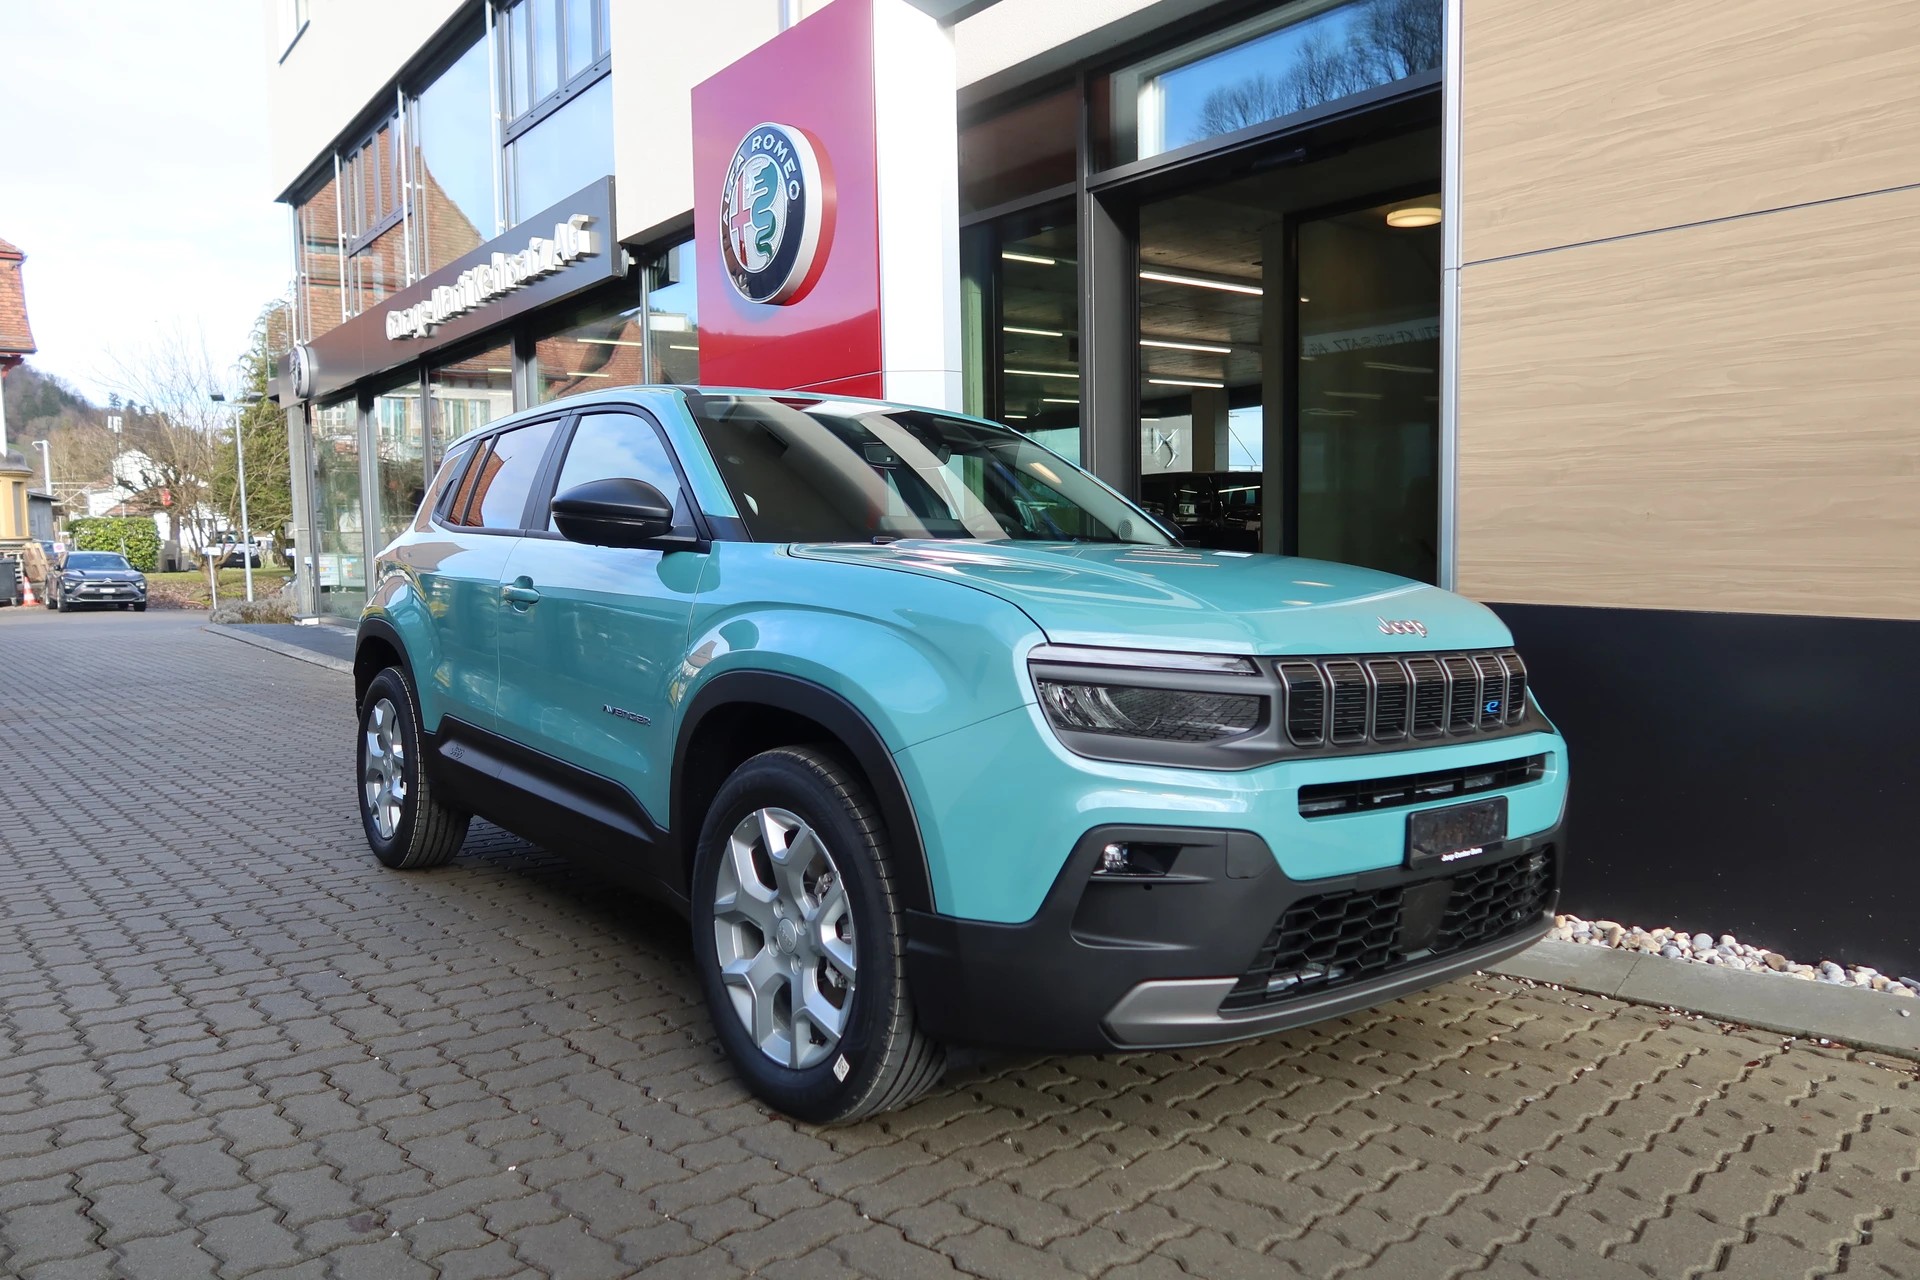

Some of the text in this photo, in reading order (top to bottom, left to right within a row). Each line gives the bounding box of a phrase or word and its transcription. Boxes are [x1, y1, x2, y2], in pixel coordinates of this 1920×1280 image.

[722, 134, 801, 227] ALFA ROMEO
[386, 300, 434, 341] Garage
[553, 213, 590, 266] AG
[1376, 616, 1428, 638] Jeep
[602, 703, 652, 726] AVENGER
